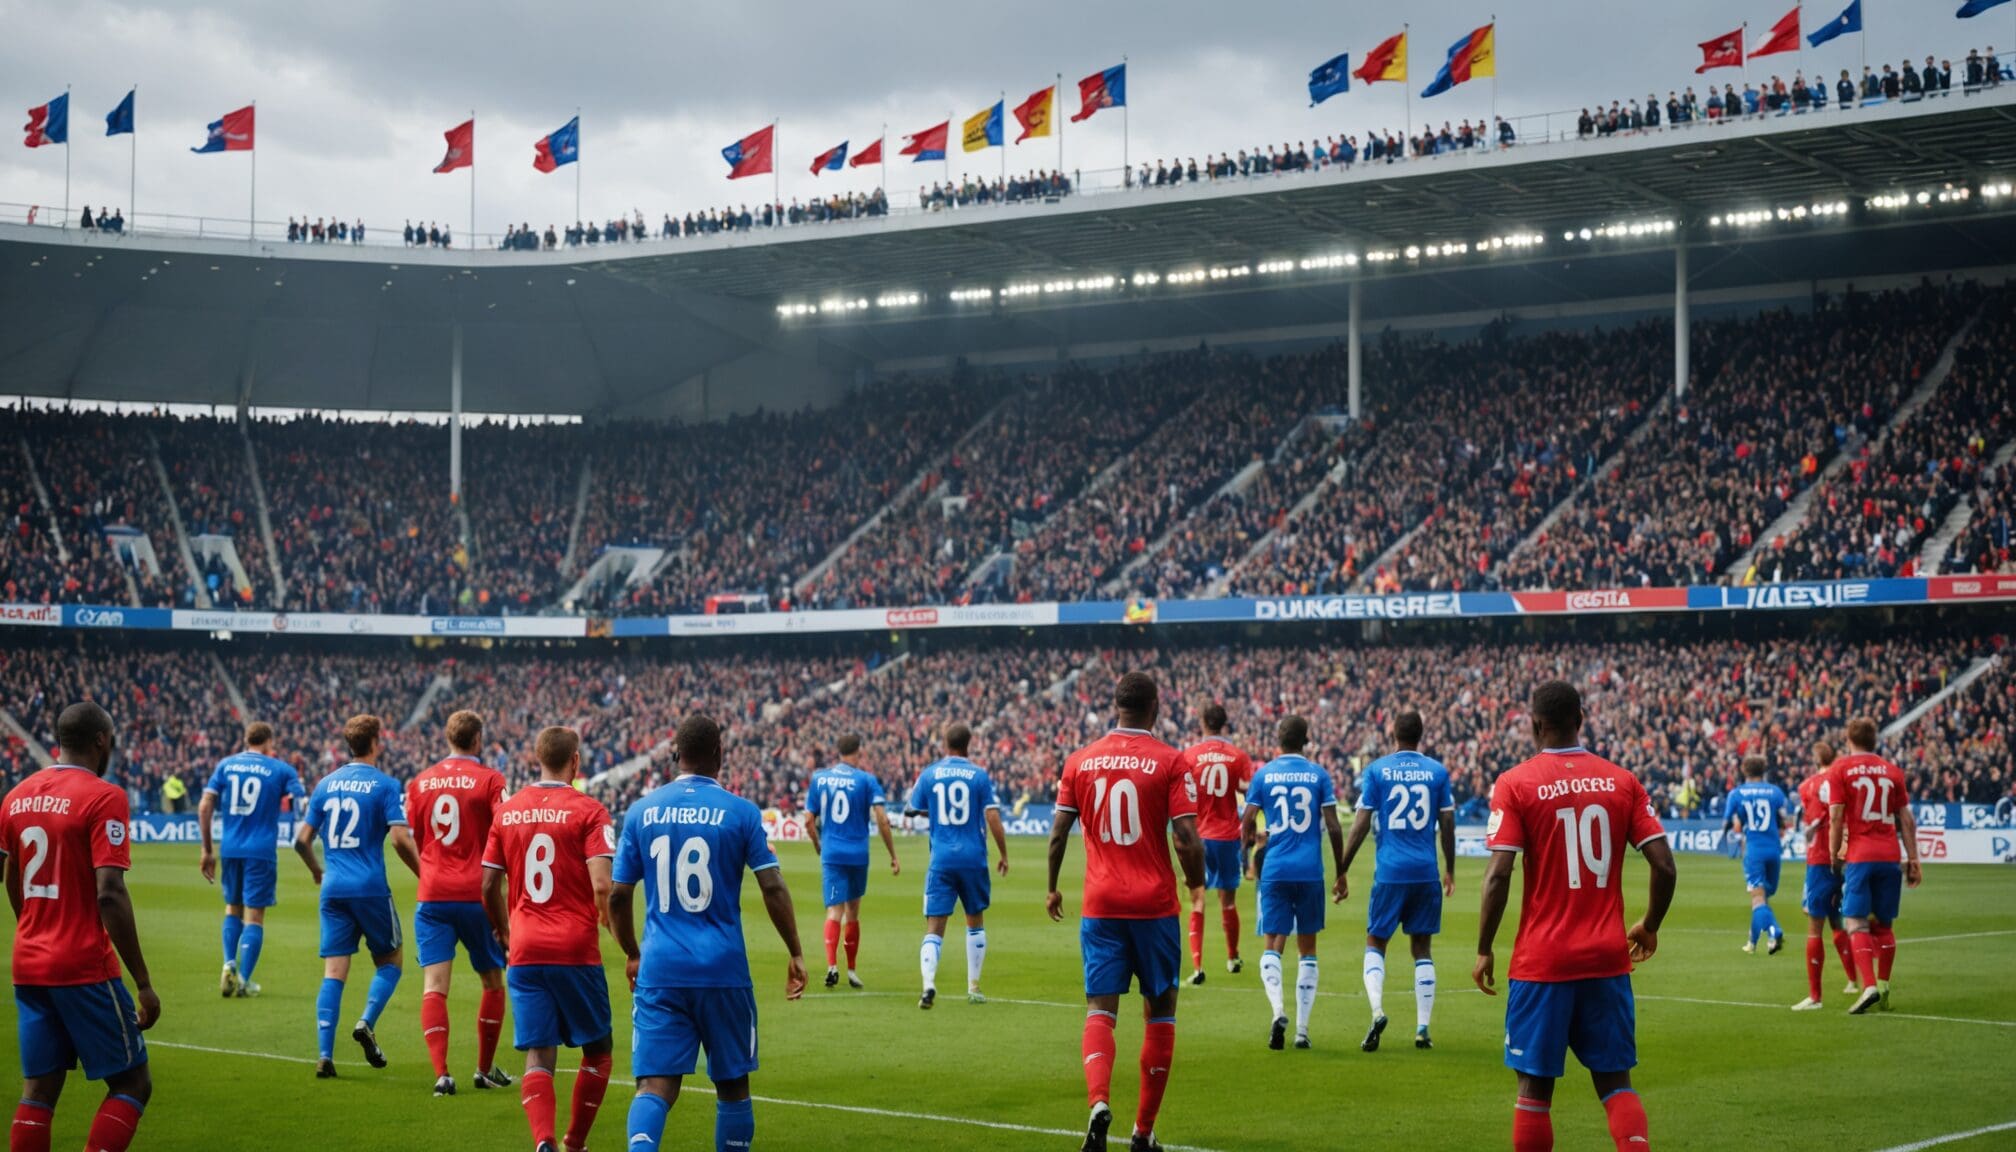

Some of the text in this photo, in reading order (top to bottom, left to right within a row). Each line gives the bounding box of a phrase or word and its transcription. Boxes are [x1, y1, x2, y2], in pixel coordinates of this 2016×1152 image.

[227, 774, 261, 816] 19
[431, 794, 460, 846] 9
[932, 781, 969, 825] 19
[1387, 784, 1431, 831] 23
[1852, 776, 1895, 824] 21
[323, 797, 360, 849] 12
[20, 826, 59, 899] 2
[525, 833, 555, 904] 8
[650, 834, 714, 913] 18
